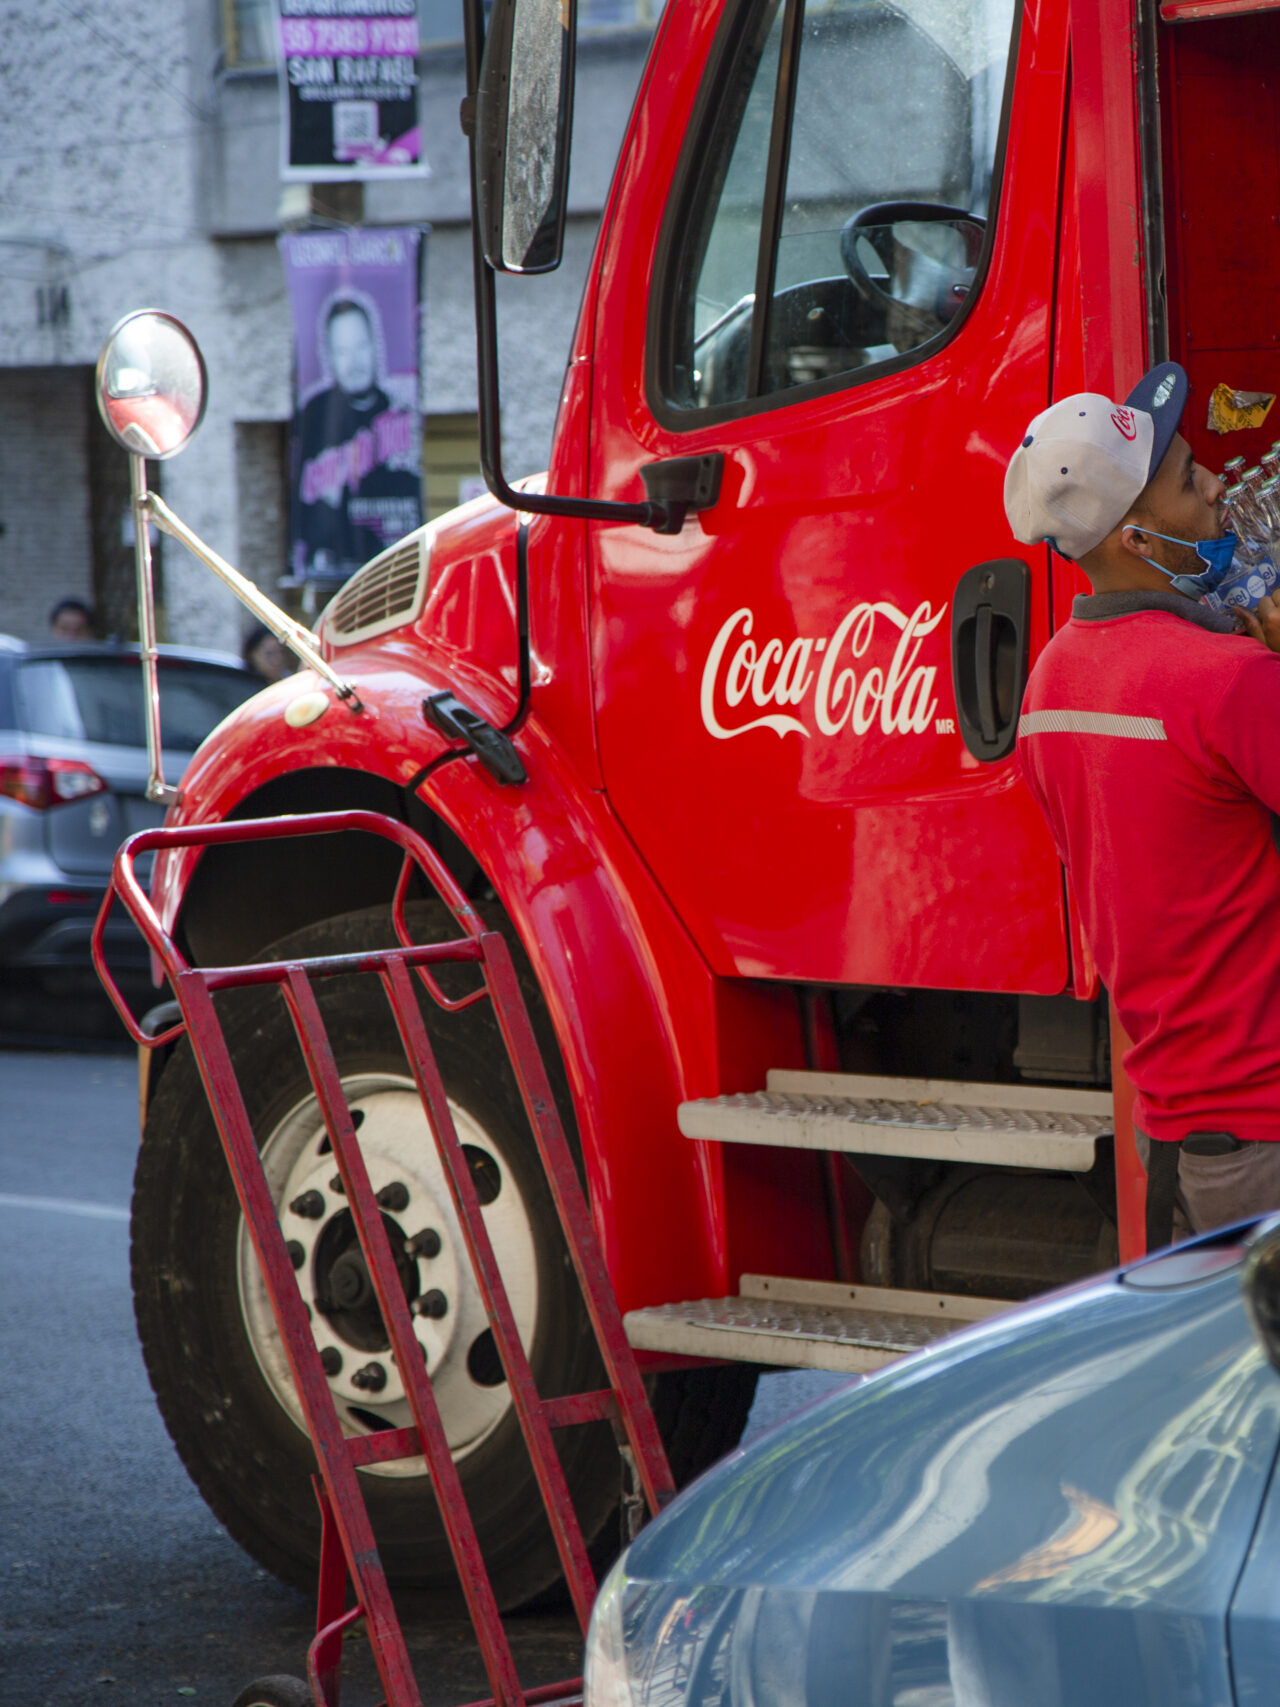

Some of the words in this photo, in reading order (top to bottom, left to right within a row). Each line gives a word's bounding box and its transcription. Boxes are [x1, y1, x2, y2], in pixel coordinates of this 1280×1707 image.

[288, 56, 334, 86] SAN
[701, 600, 948, 740] Coca-Cola
[935, 719, 955, 734] MR
